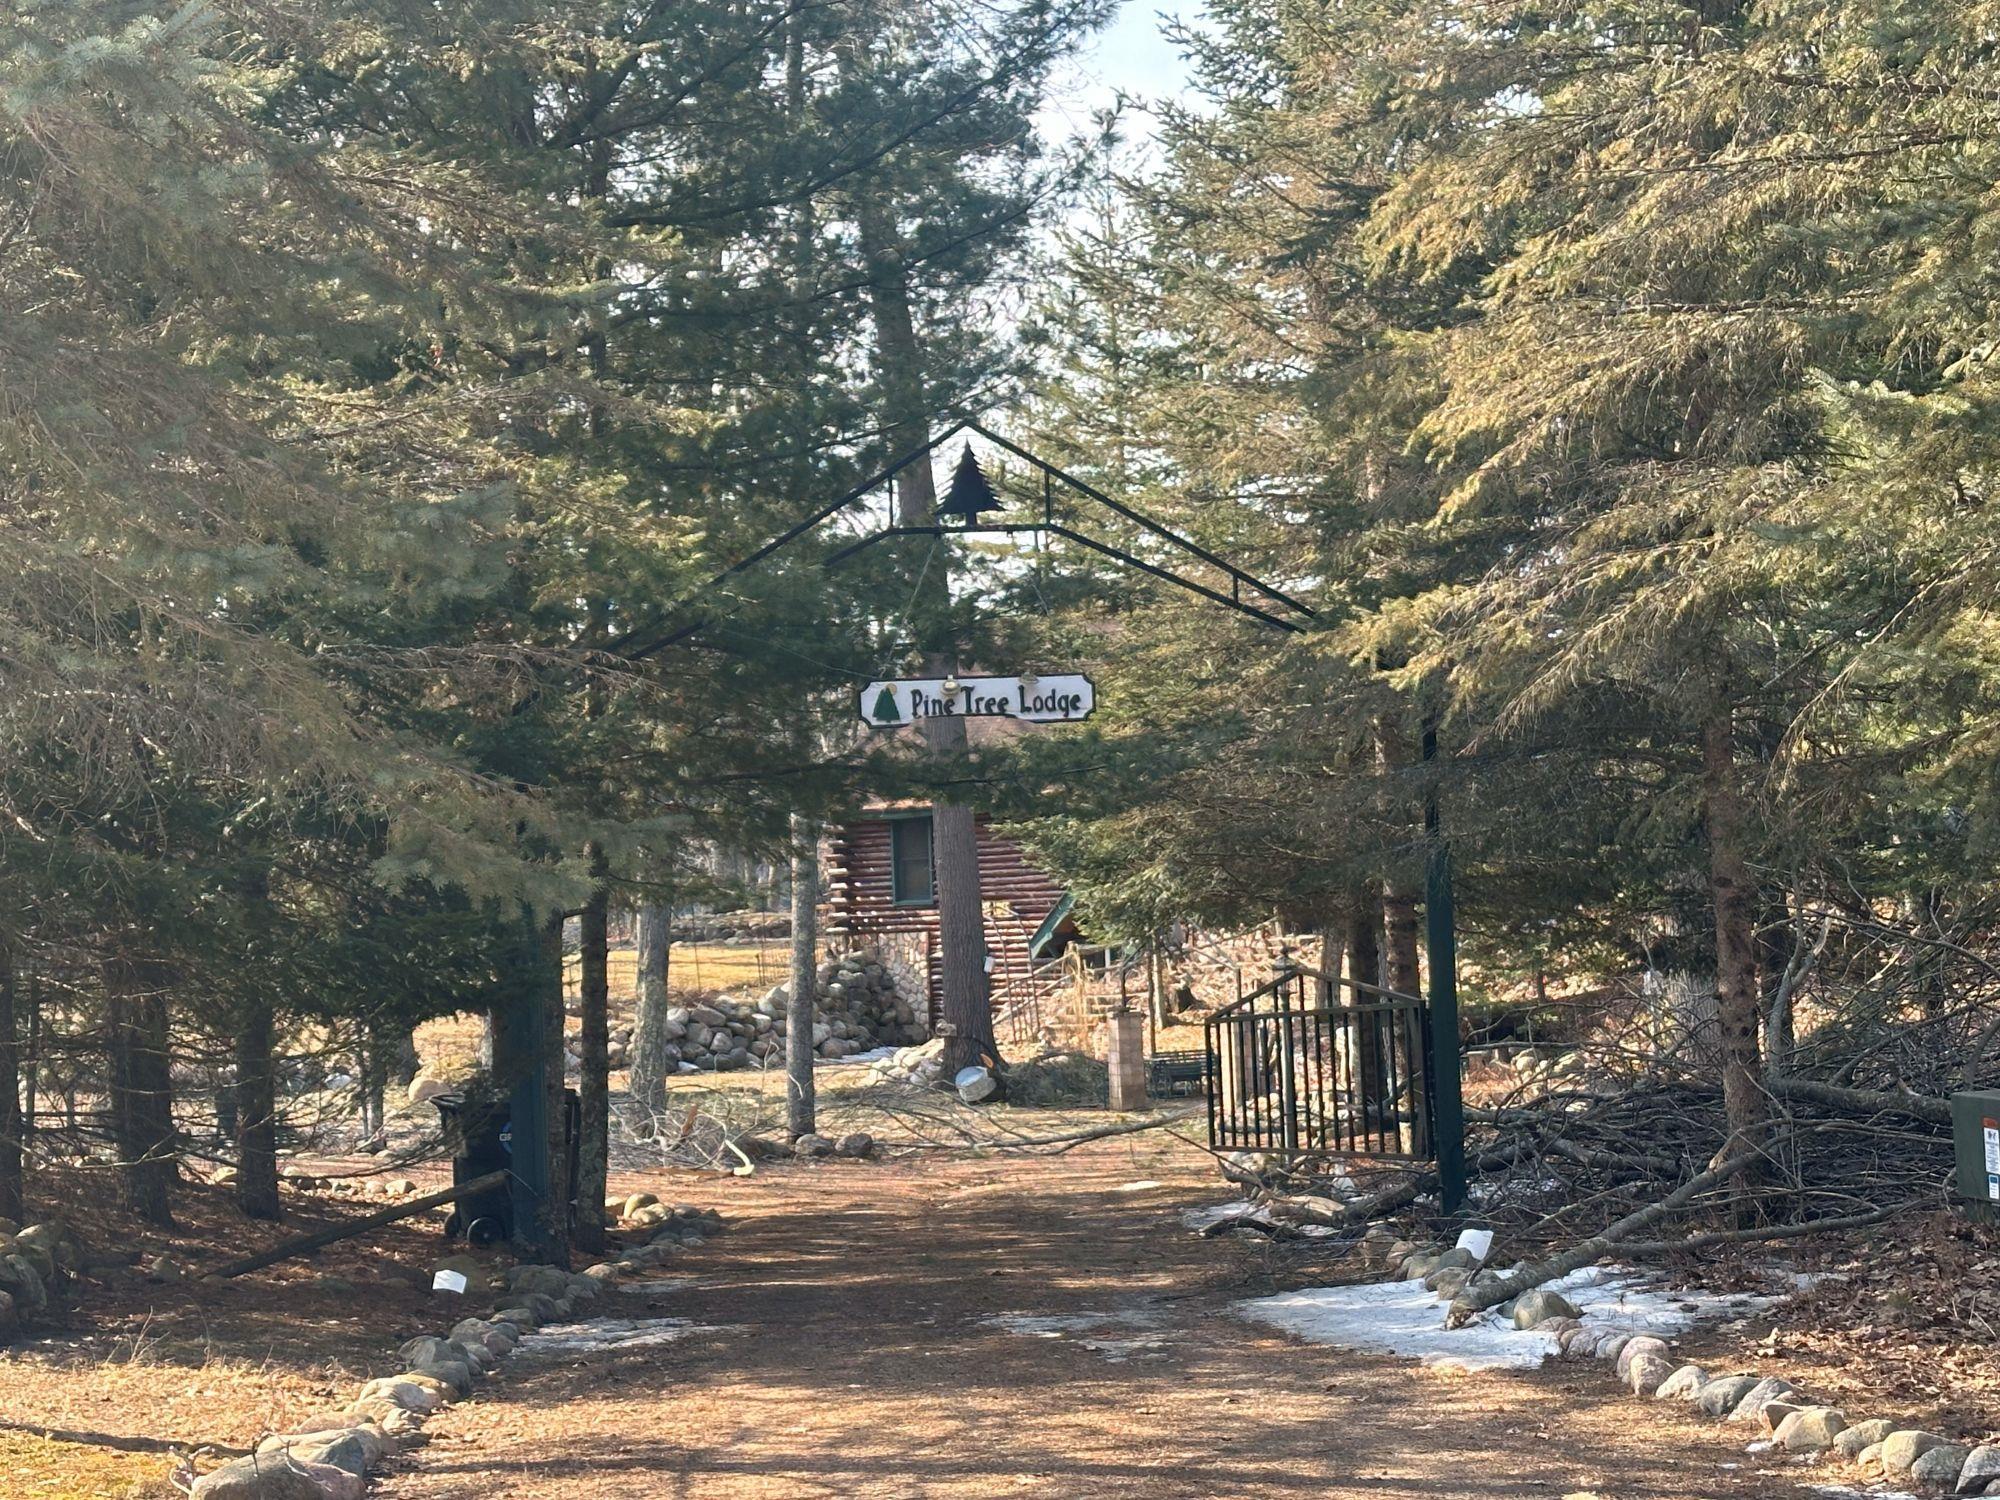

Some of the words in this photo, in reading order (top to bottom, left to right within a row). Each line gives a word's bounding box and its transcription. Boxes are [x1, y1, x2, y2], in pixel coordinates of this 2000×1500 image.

[911, 689, 955, 719] Pine
[961, 685, 1010, 715] Tree
[1018, 685, 1081, 718] Lodge
